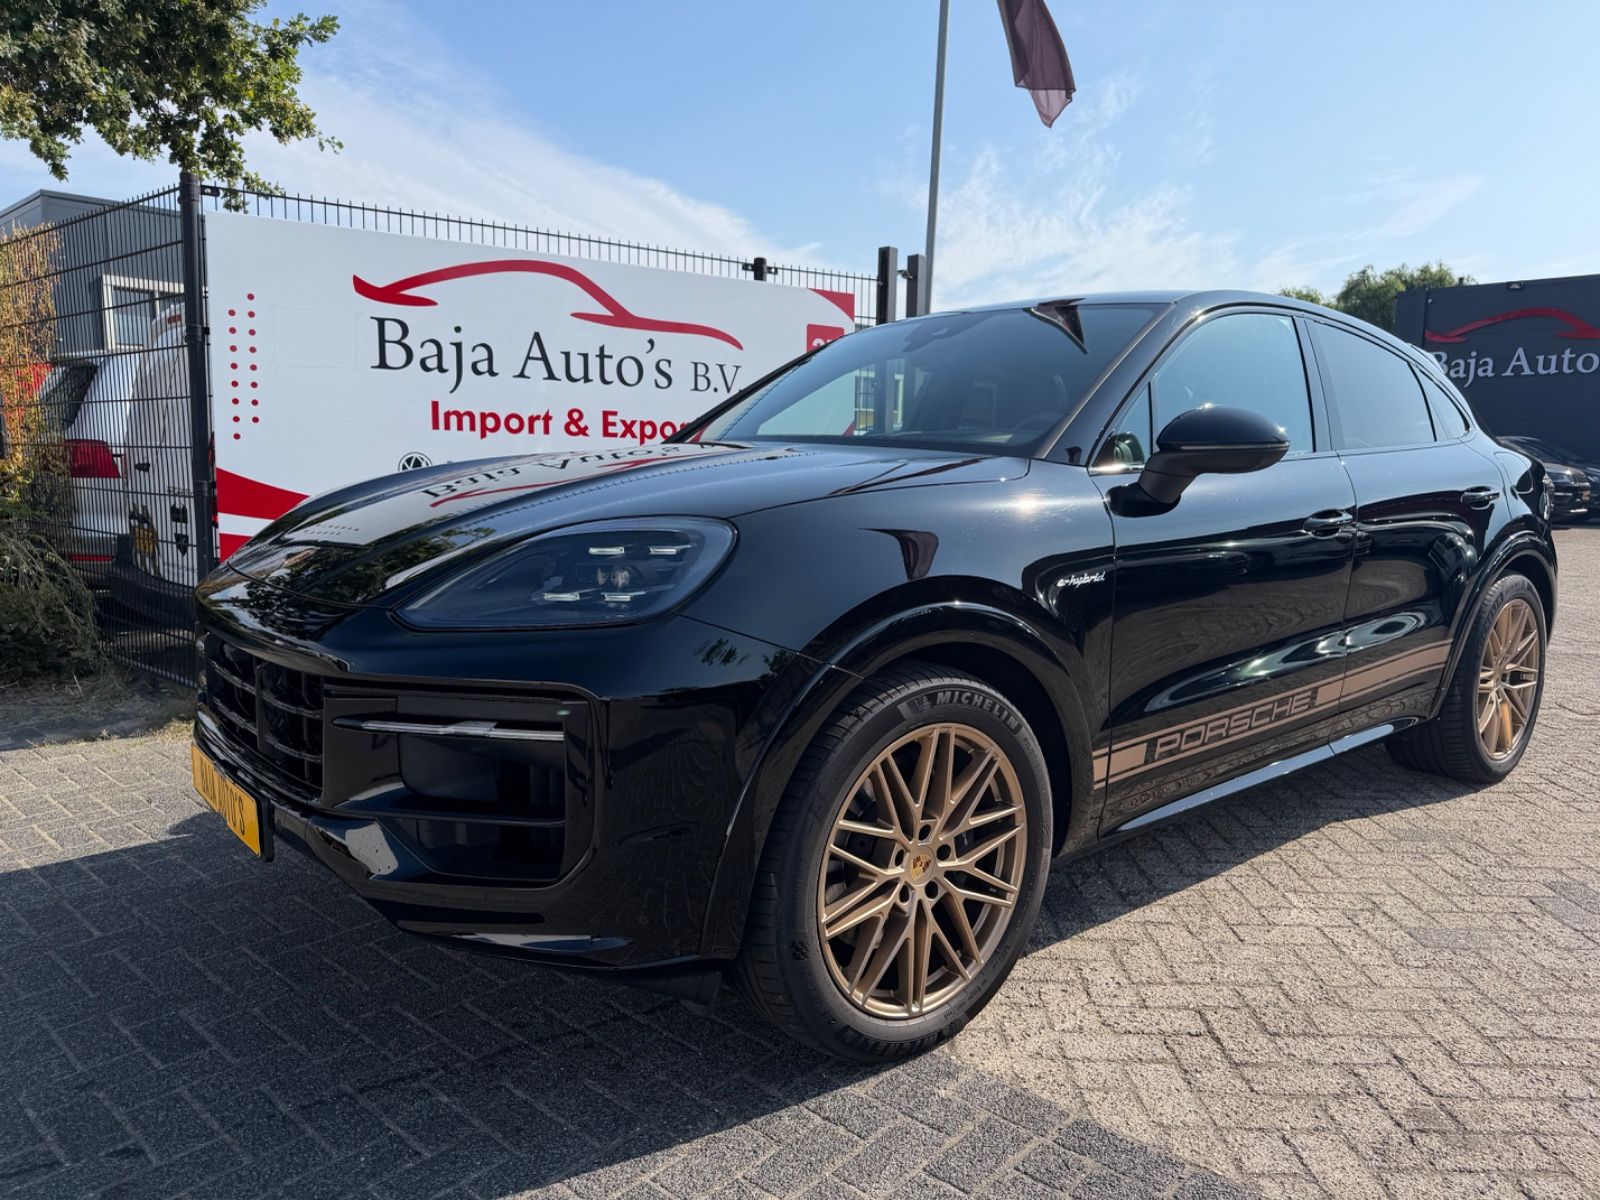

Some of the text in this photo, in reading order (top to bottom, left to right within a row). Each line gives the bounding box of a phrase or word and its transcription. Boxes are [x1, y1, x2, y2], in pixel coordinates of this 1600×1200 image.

[370, 316, 500, 394] Baja
[513, 331, 673, 390] Auto's
[430, 401, 688, 445] Import & Expo
[936, 690, 1020, 732] MICHELIN
[1155, 690, 1312, 760] PORSCHE
